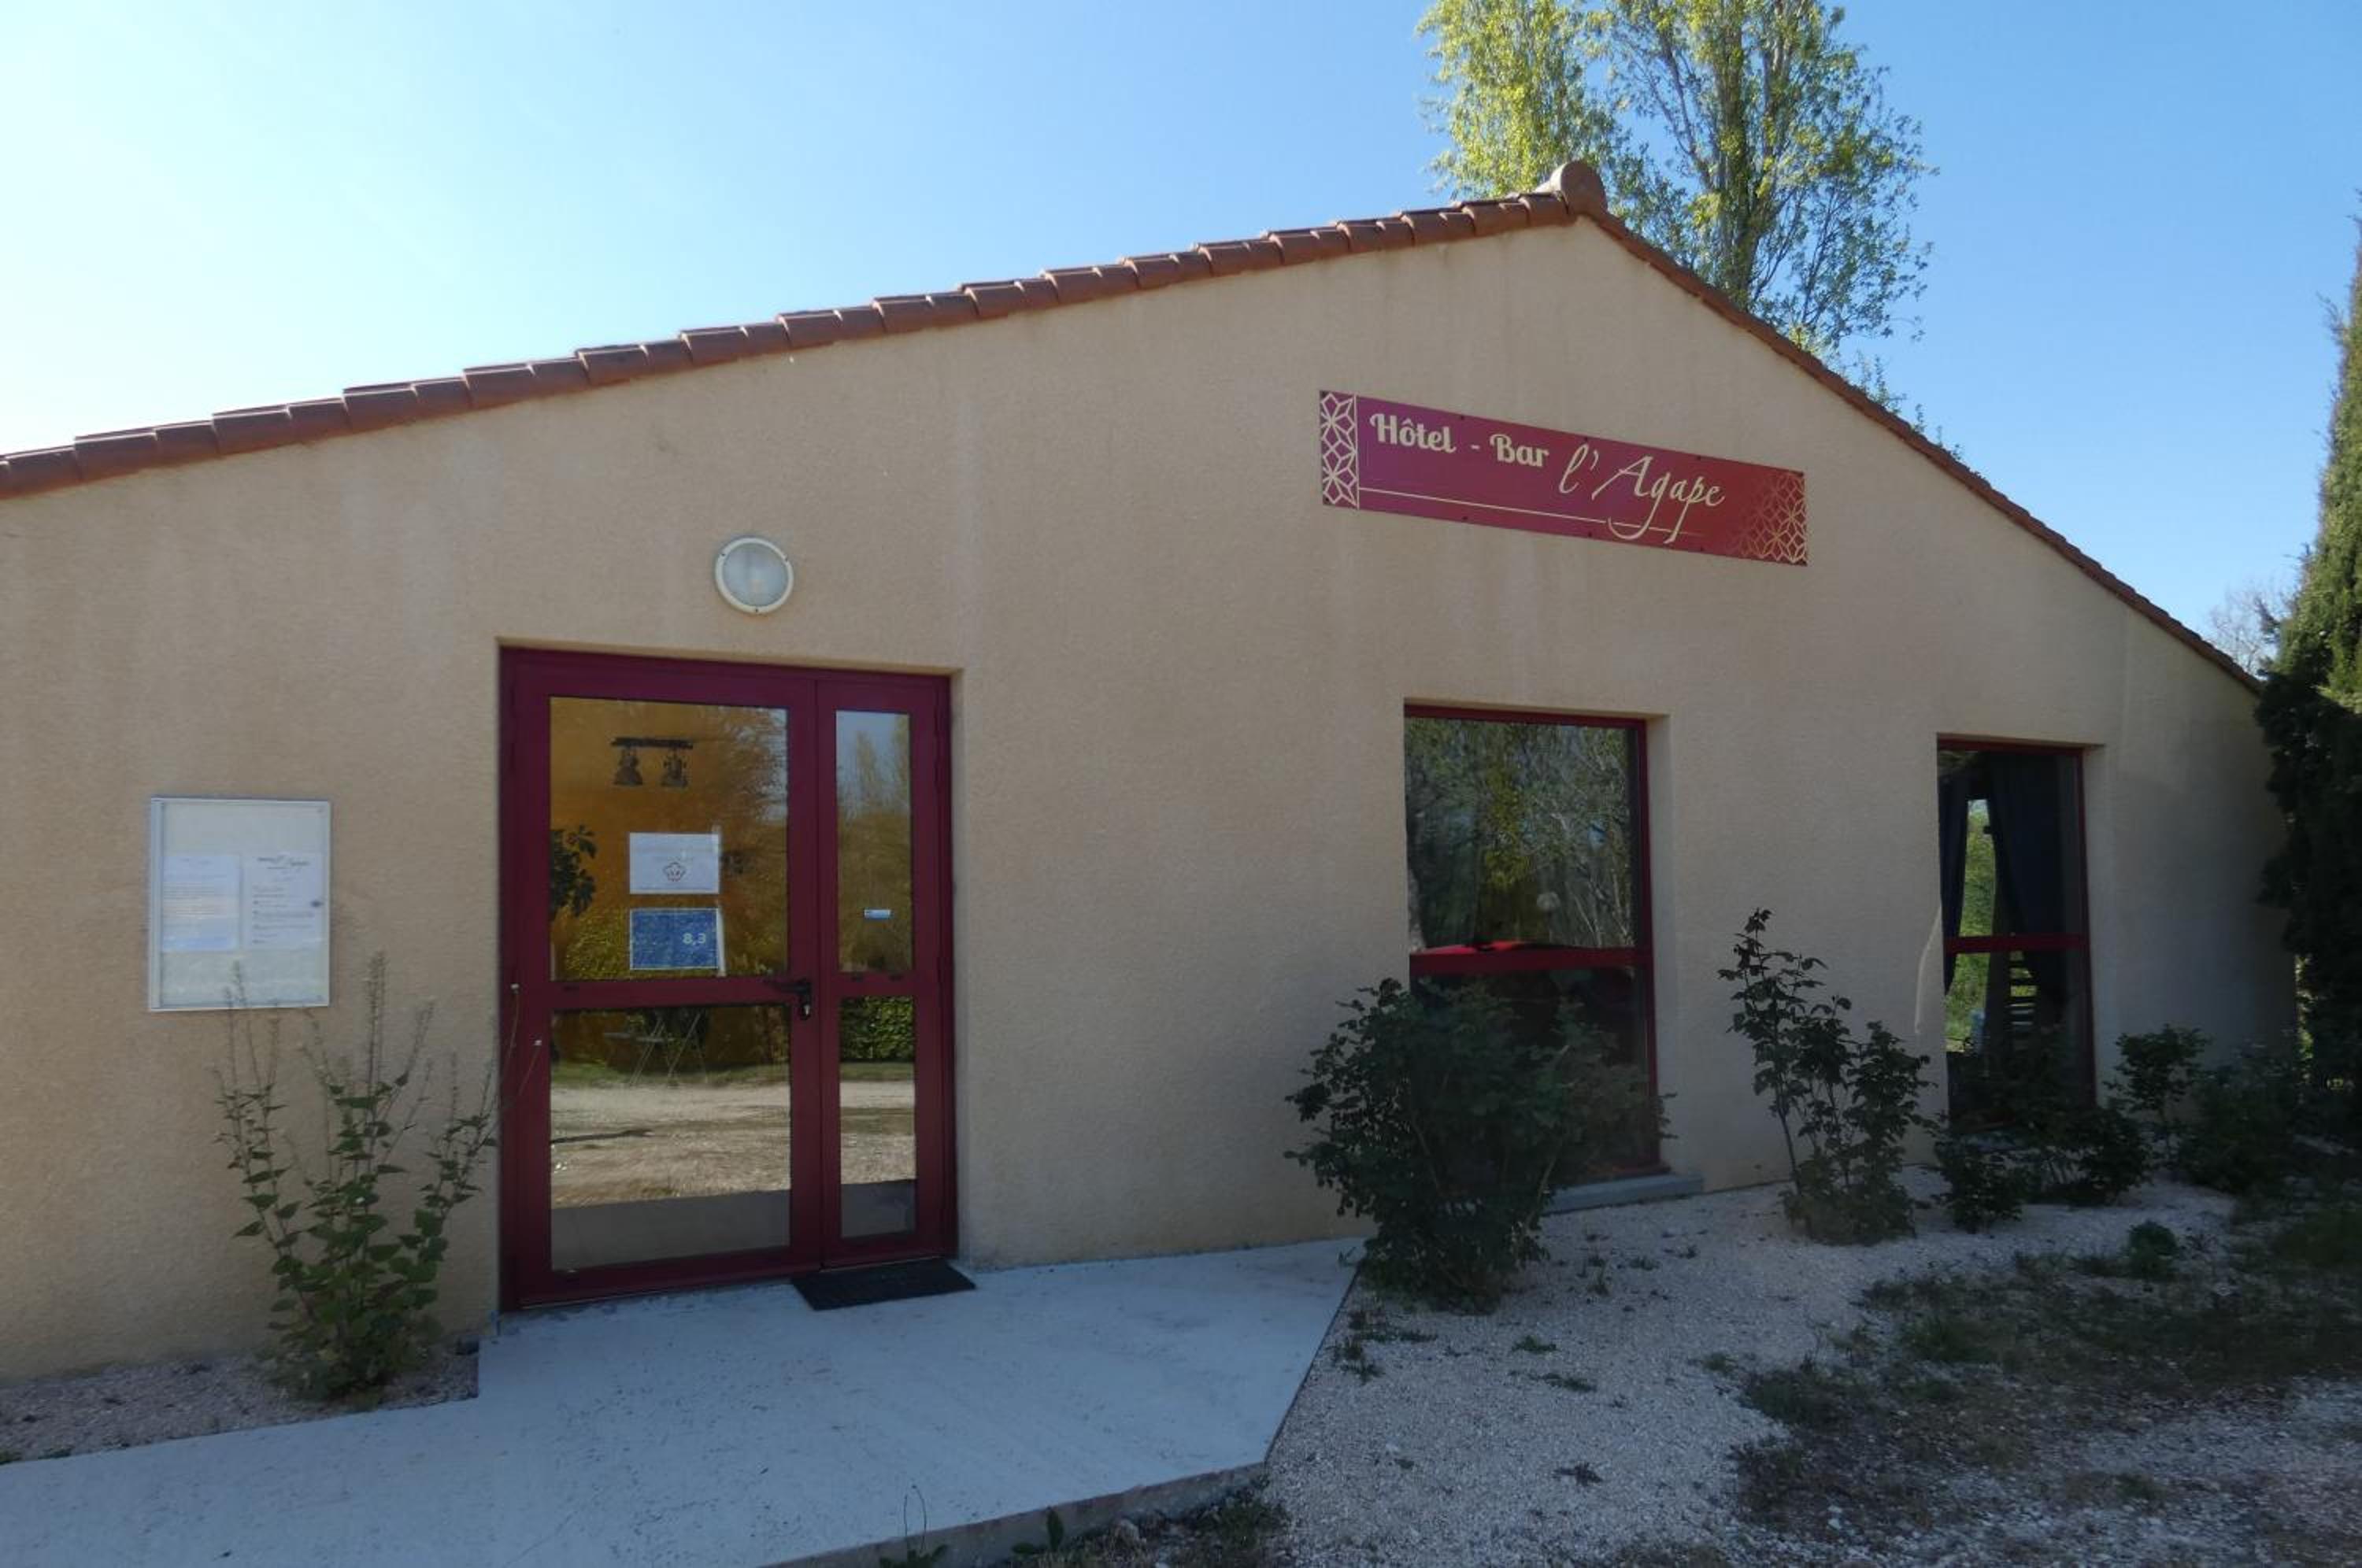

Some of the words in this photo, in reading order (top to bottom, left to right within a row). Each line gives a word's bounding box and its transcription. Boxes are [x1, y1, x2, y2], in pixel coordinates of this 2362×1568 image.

[1369, 412, 1457, 453] Hôtel
[1489, 434, 1549, 467] Bar
[682, 933, 706, 945] 8,3
